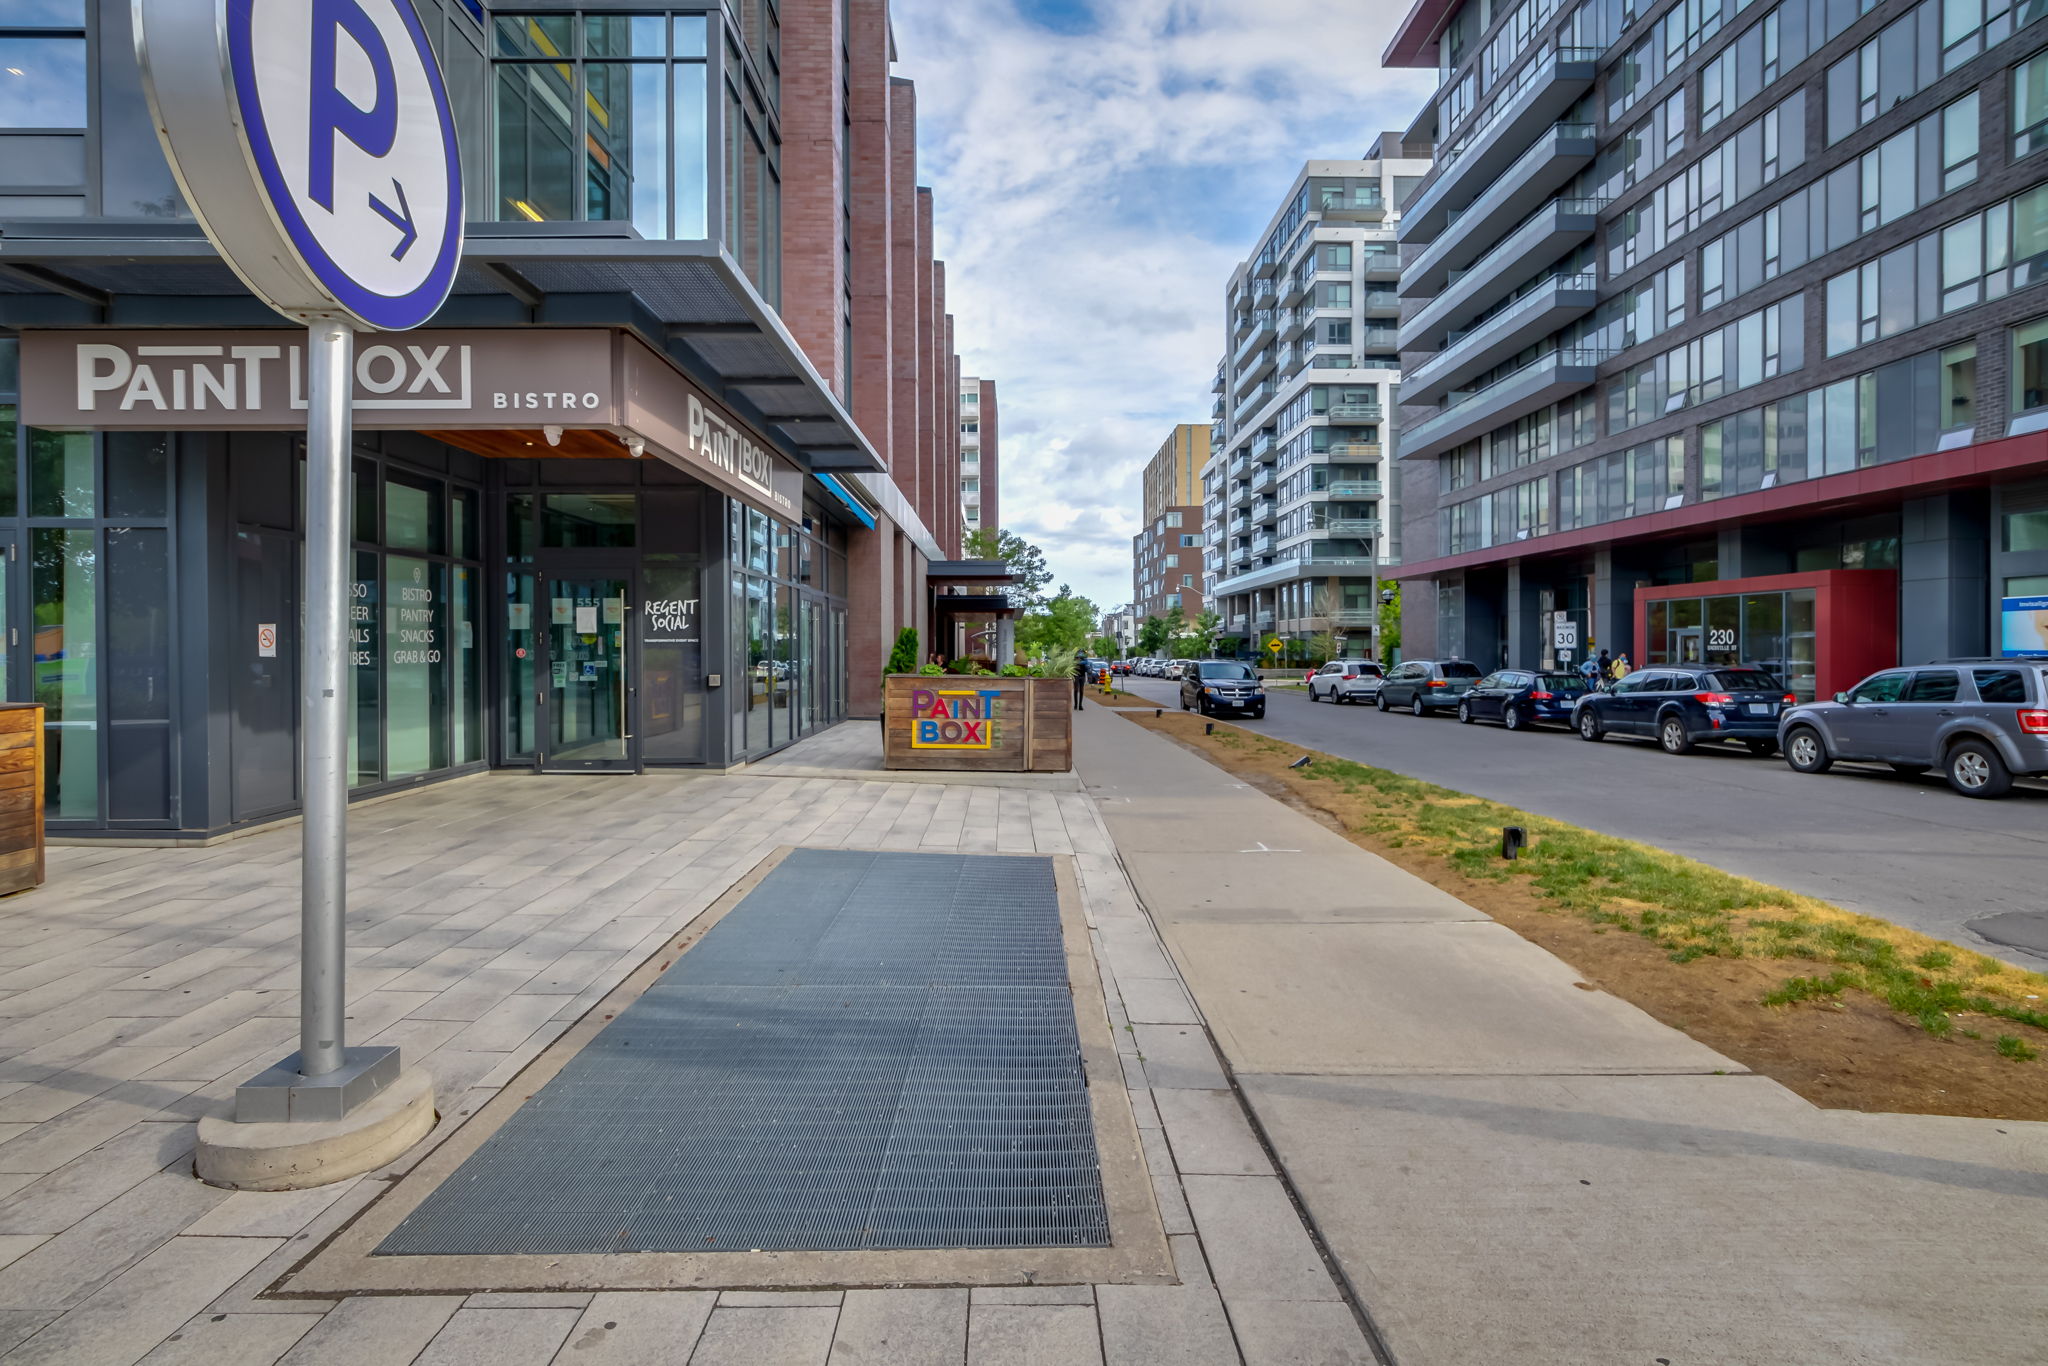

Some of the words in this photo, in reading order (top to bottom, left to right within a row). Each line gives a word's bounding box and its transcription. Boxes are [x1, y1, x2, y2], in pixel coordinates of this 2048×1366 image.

[308, 0, 398, 215] P
[77, 343, 280, 410] PAINT
[493, 392, 600, 409] BISTRO
[687, 393, 738, 475] PAINT
[742, 437, 770, 487] BOX
[774, 490, 791, 510] BISTRO
[402, 587, 432, 602] BISTRO
[577, 598, 600, 608] 555
[645, 599, 699, 616] REGENT
[350, 606, 369, 621] EER
[401, 608, 434, 623] PANTRY
[651, 614, 689, 632] SOCIAL
[400, 629, 434, 643] SNACKS
[1557, 633, 1575, 645] 30
[1710, 629, 1735, 645] 230
[349, 651, 370, 666] IBES
[393, 650, 418, 664] GRAB
[420, 650, 426, 663] &
[427, 649, 441, 663] GO
[912, 690, 1001, 719] PAINT
[920, 721, 982, 743] BOX
